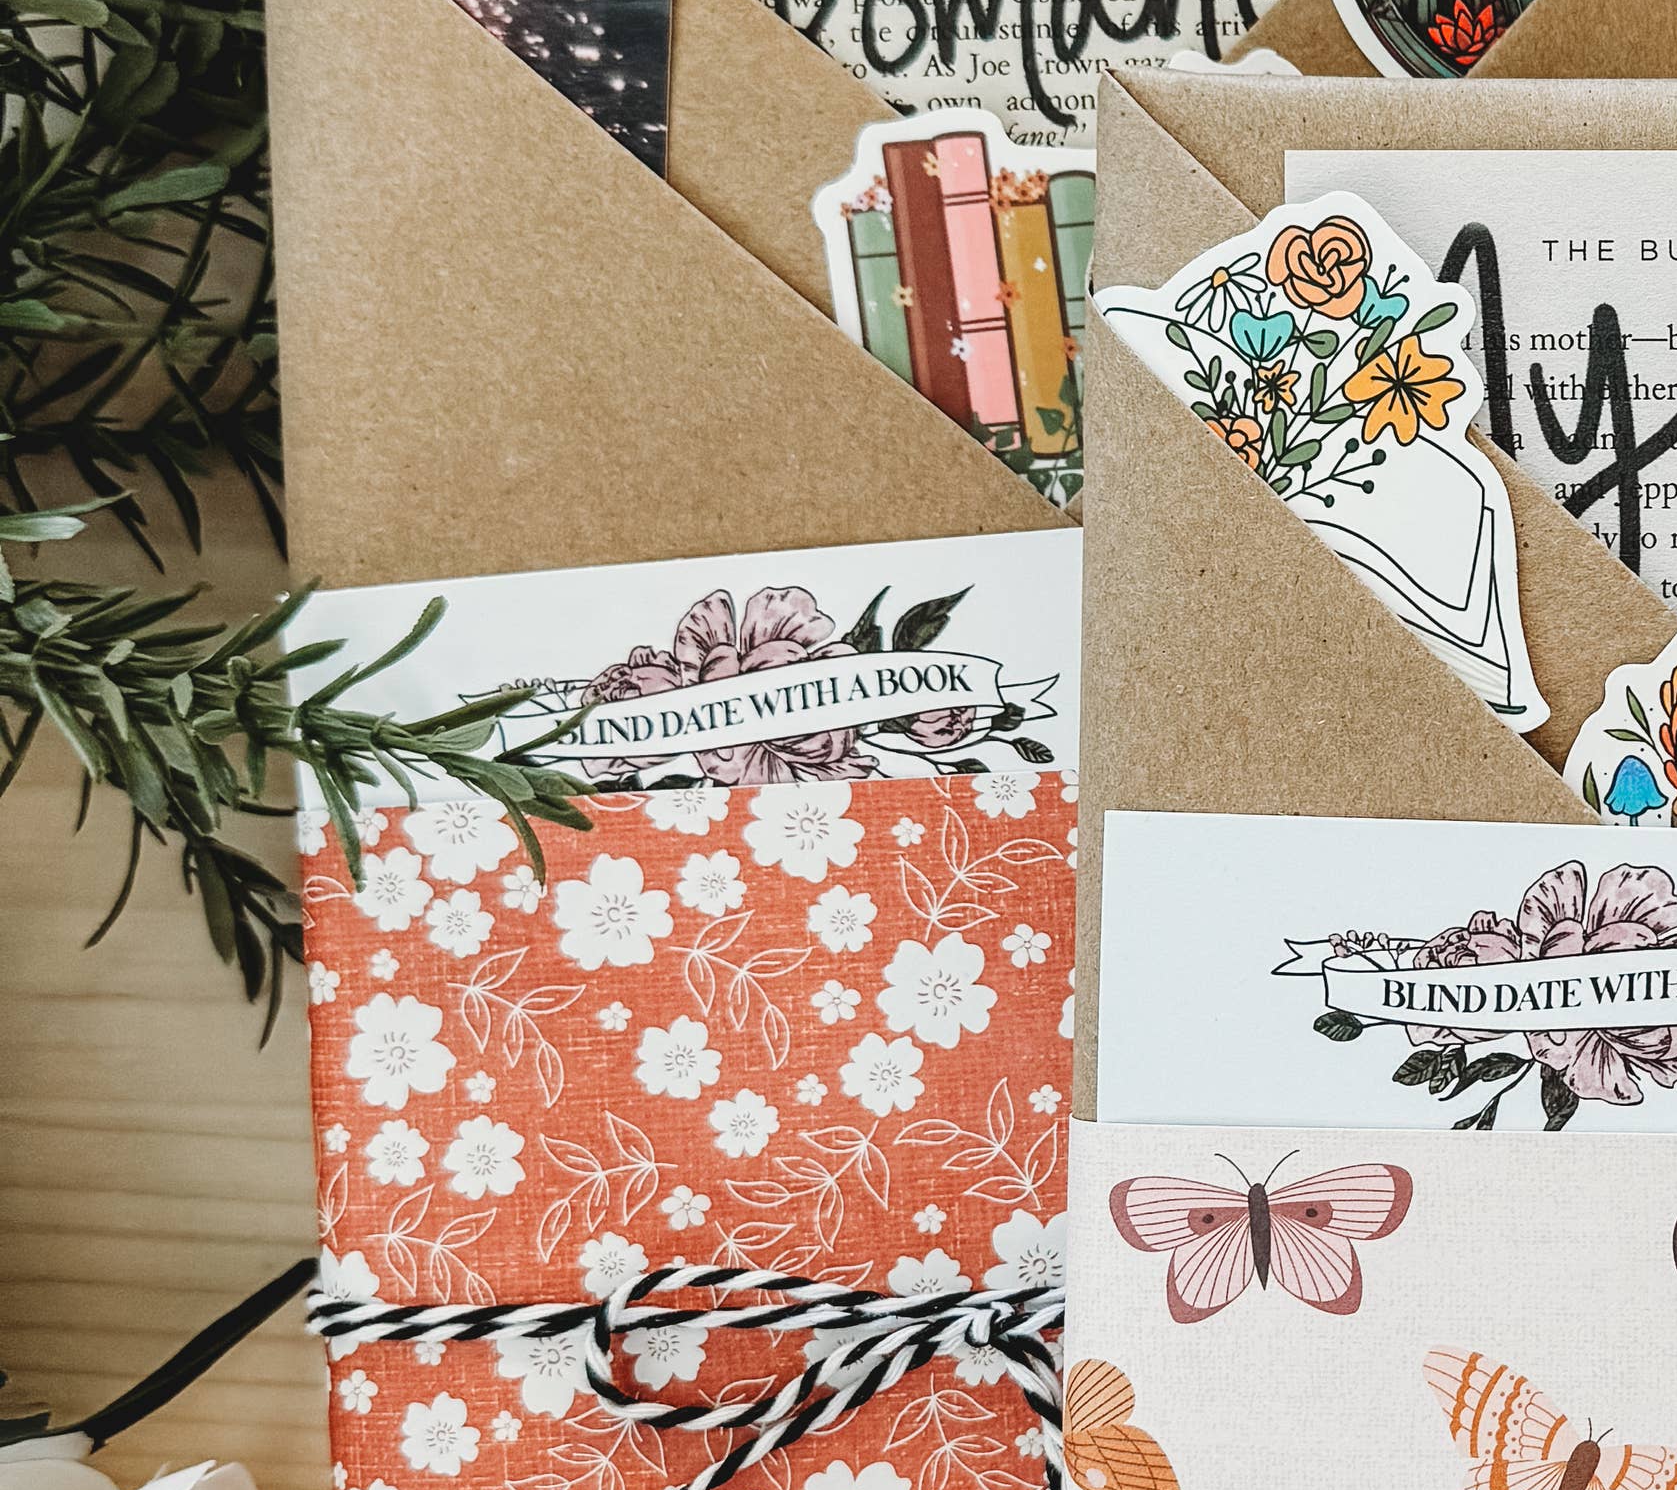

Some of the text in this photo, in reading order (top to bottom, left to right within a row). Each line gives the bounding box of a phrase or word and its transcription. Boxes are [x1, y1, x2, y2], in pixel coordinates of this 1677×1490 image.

[924, 53, 956, 77] As
[966, 52, 1010, 84] Joe
[1541, 239, 1615, 262] THE
[661, 699, 744, 739] DATE
[747, 676, 842, 721] WITH
[846, 673, 871, 701] A
[874, 663, 975, 696] BOOK
[1381, 977, 1488, 1014] BLIND
[1493, 978, 1582, 1012] DATE
